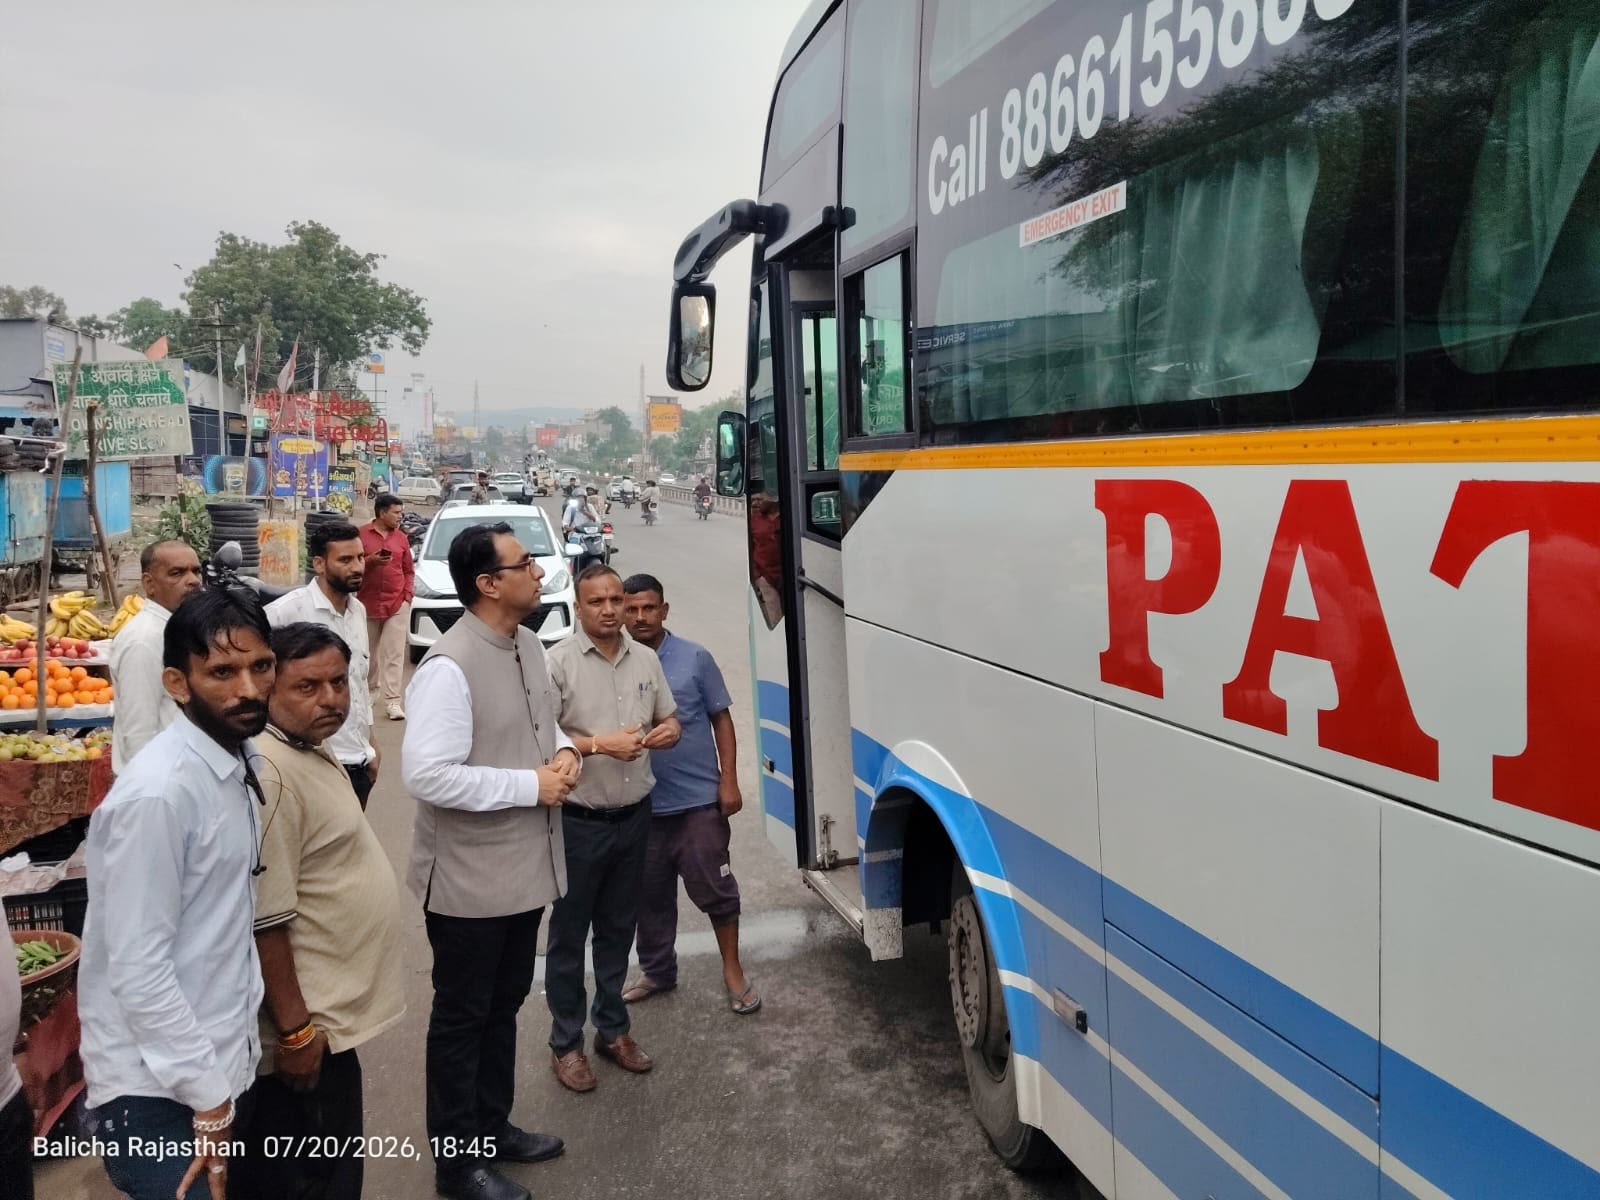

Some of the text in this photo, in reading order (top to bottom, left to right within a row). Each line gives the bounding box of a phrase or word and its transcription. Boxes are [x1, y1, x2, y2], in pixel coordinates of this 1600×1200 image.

[928, 0, 1355, 216] Call 88661558
[1024, 187, 1121, 242] EMERGENCY EXIT
[71, 416, 136, 431] OWNSHIP
[1095, 479, 1600, 831] PAT
